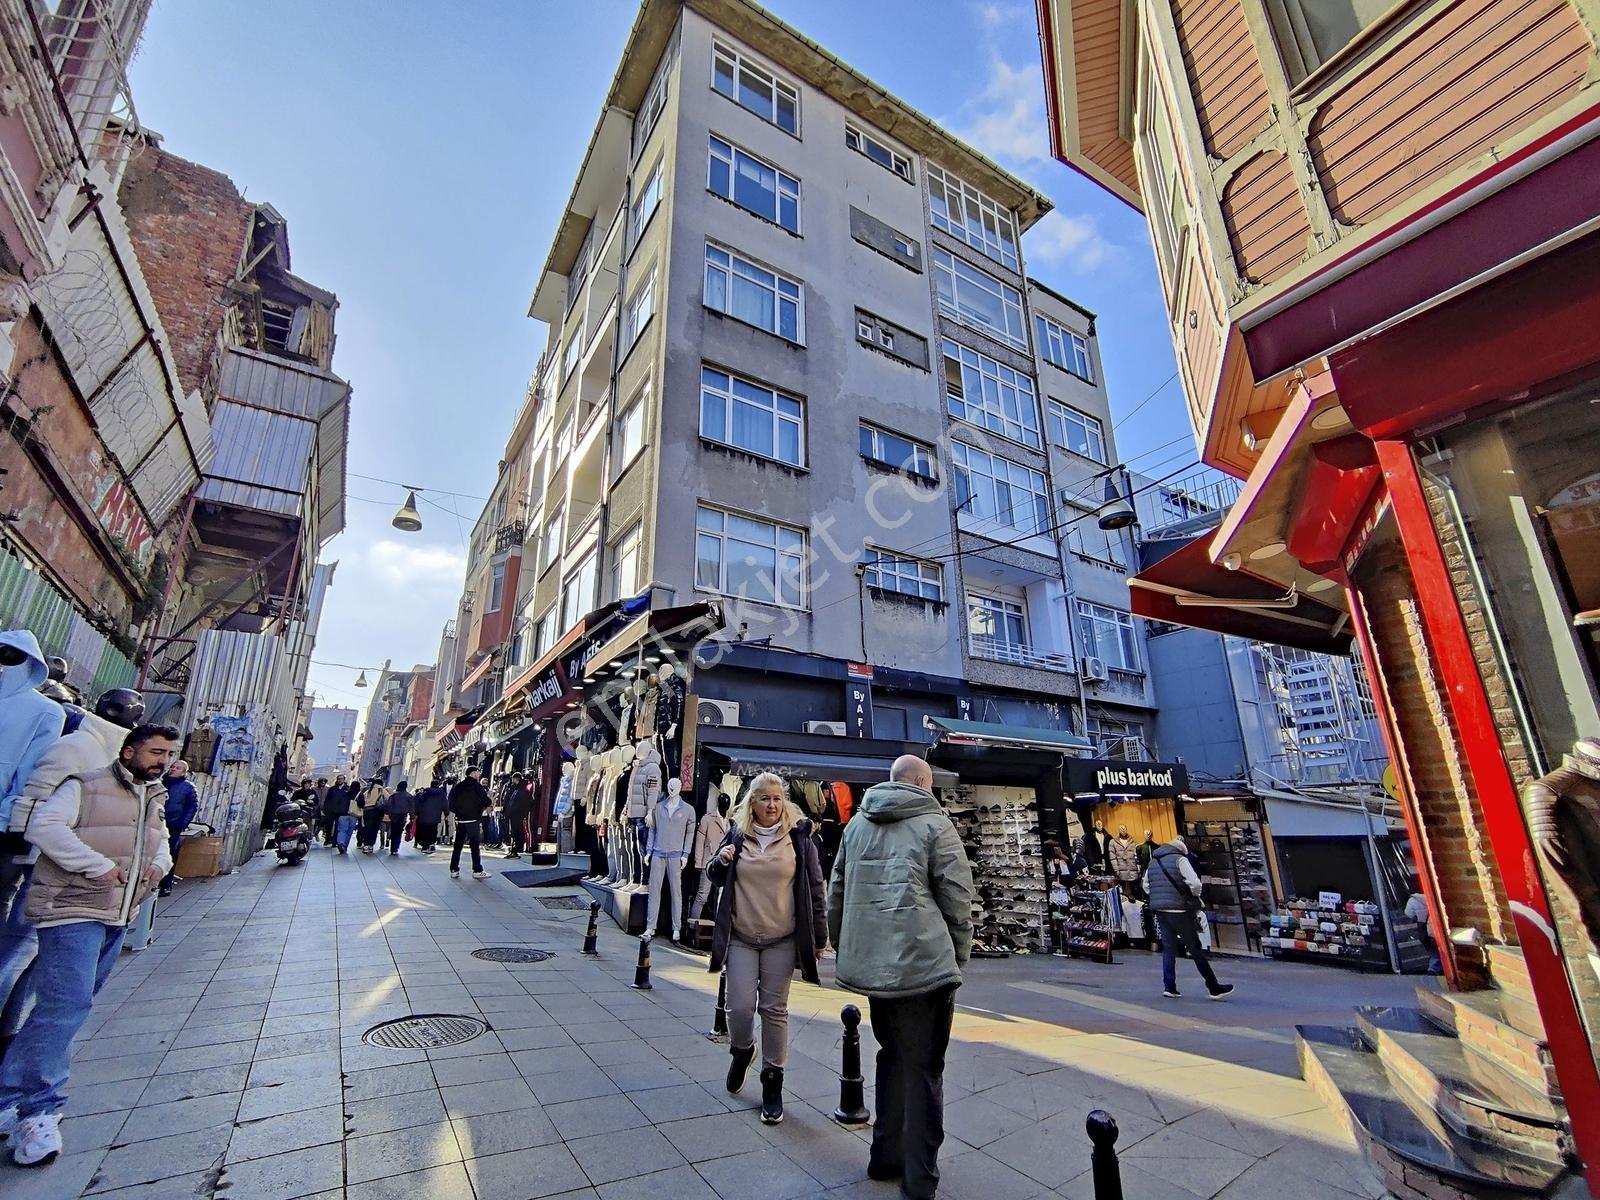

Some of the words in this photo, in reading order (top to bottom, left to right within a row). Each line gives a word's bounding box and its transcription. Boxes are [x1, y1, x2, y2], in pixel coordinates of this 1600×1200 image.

[854, 690, 865, 702] By
[960, 700, 970, 711] By
[1096, 766, 1127, 789] plus
[1127, 767, 1173, 787] barkod
